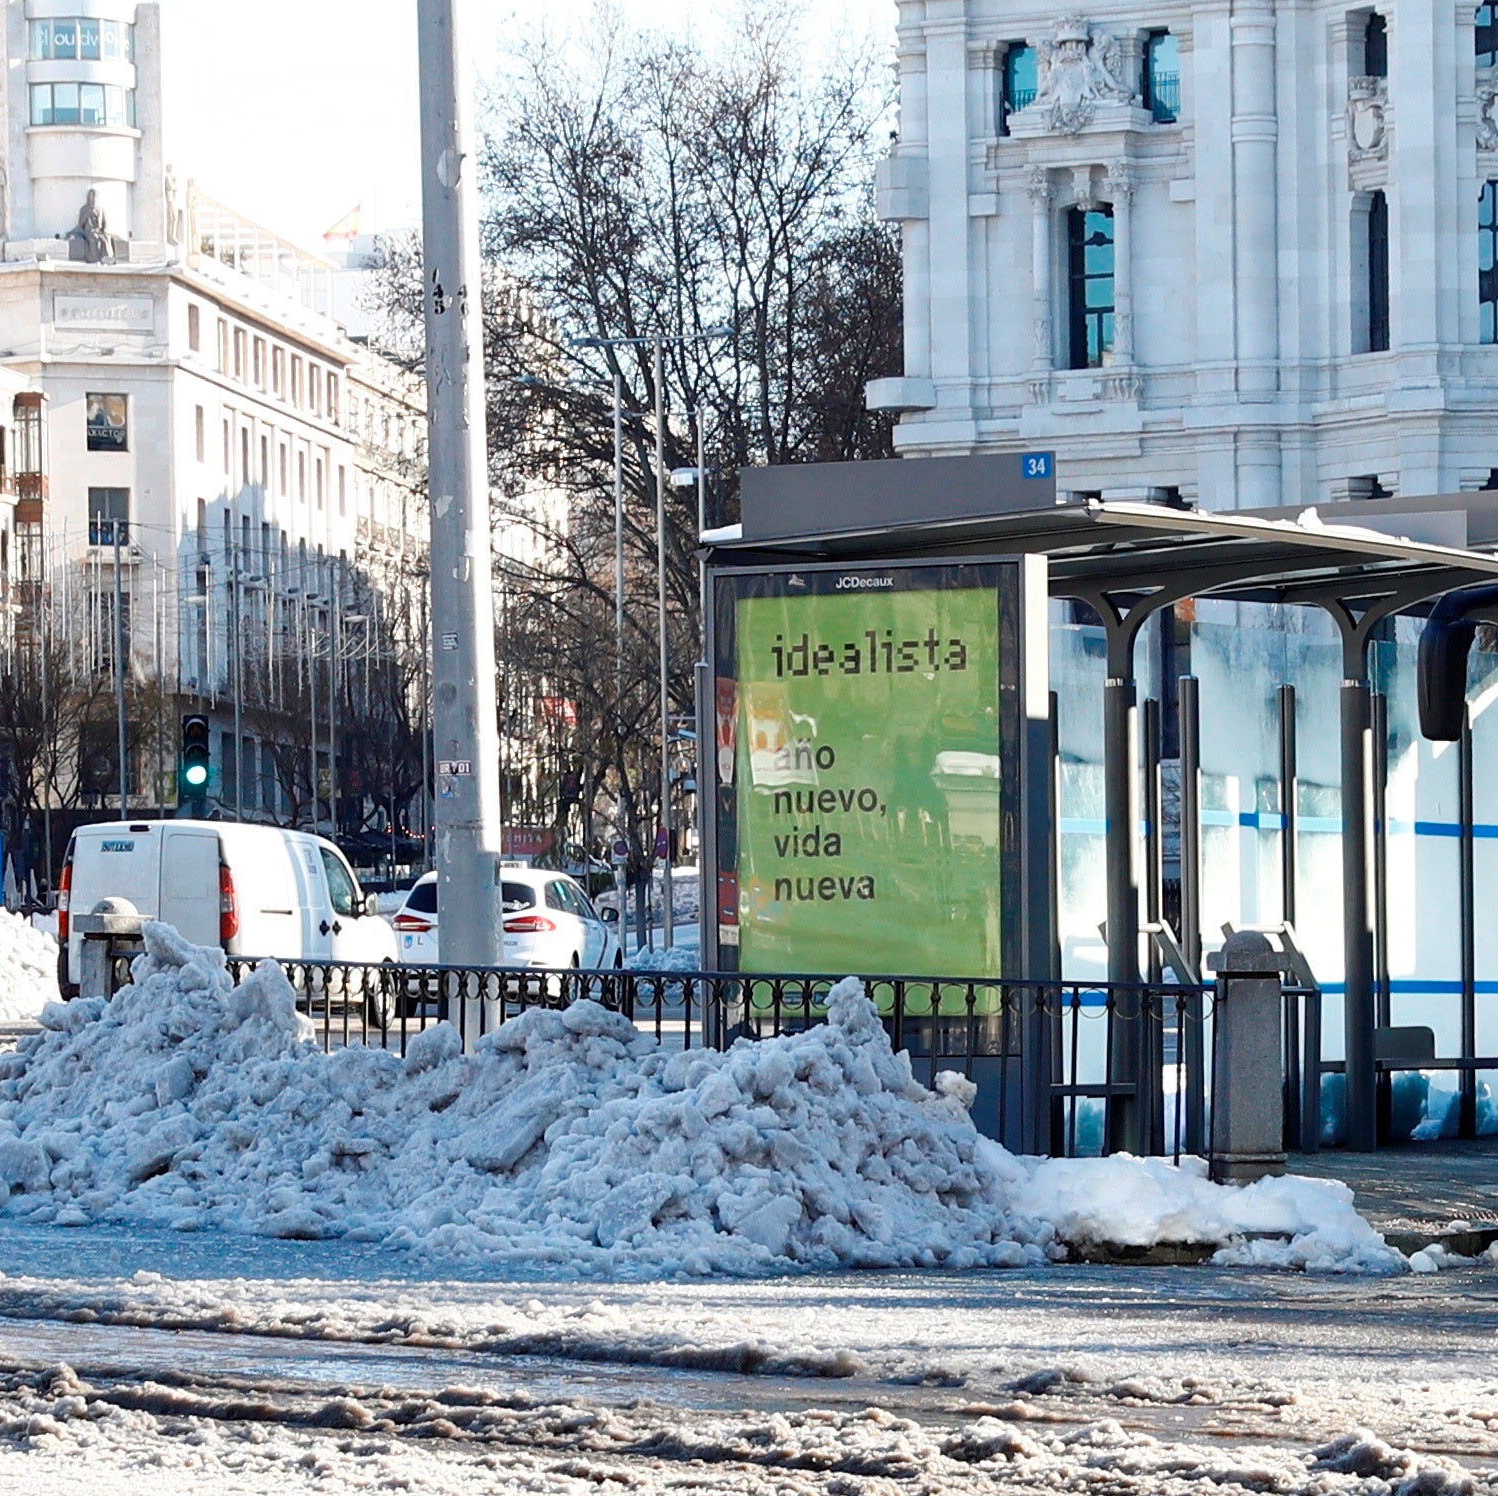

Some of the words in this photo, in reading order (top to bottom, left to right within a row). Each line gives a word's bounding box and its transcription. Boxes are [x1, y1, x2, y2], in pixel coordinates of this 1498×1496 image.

[1028, 457, 1046, 476] 34
[836, 576, 894, 589] JCDecaux
[771, 628, 968, 677] idealista
[774, 738, 836, 770] año
[774, 787, 886, 816] nuevo,
[774, 825, 841, 858] vida
[775, 874, 875, 901] nueva
